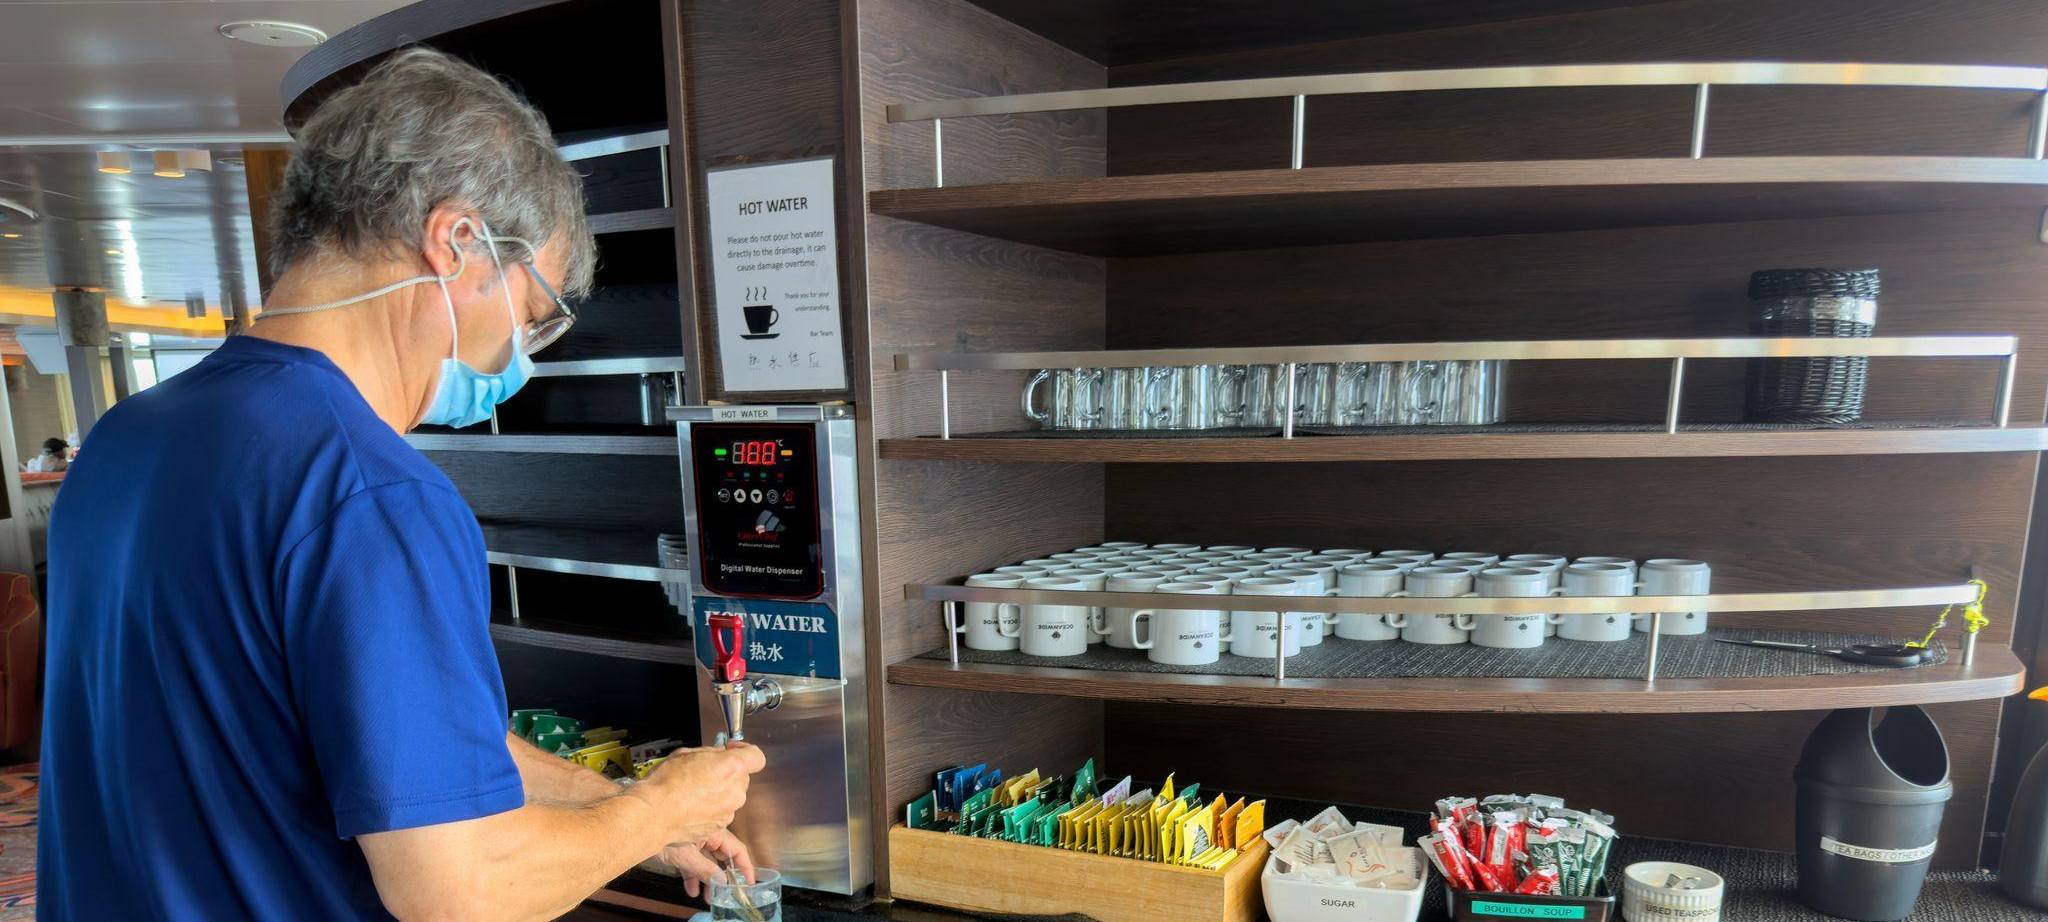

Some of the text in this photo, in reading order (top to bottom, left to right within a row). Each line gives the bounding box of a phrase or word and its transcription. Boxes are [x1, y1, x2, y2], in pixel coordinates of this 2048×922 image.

[739, 197, 808, 216] HOT WATER
[727, 236, 748, 245] Please
[749, 235, 759, 243] do
[773, 233, 789, 242] pour
[790, 232, 803, 240] hot
[804, 230, 824, 238] water
[727, 249, 752, 259] directly
[753, 249, 761, 257] to
[762, 247, 773, 256] the
[807, 245, 812, 253] it
[813, 244, 826, 253] can
[736, 264, 756, 272] cause
[757, 261, 783, 271] damage
[721, 409, 769, 418] HOT WATER
[720, 563, 804, 576] Digital Water Dispenser
[750, 613, 827, 633] WATER
[749, 641, 784, 662] 热水
[1834, 842, 1852, 855] TEA
[1854, 847, 1882, 859] BAGS
[1321, 899, 1355, 908] SUGAR
[1484, 905, 1572, 916] BOUILLON SOUP
[1646, 903, 1672, 915] USED
